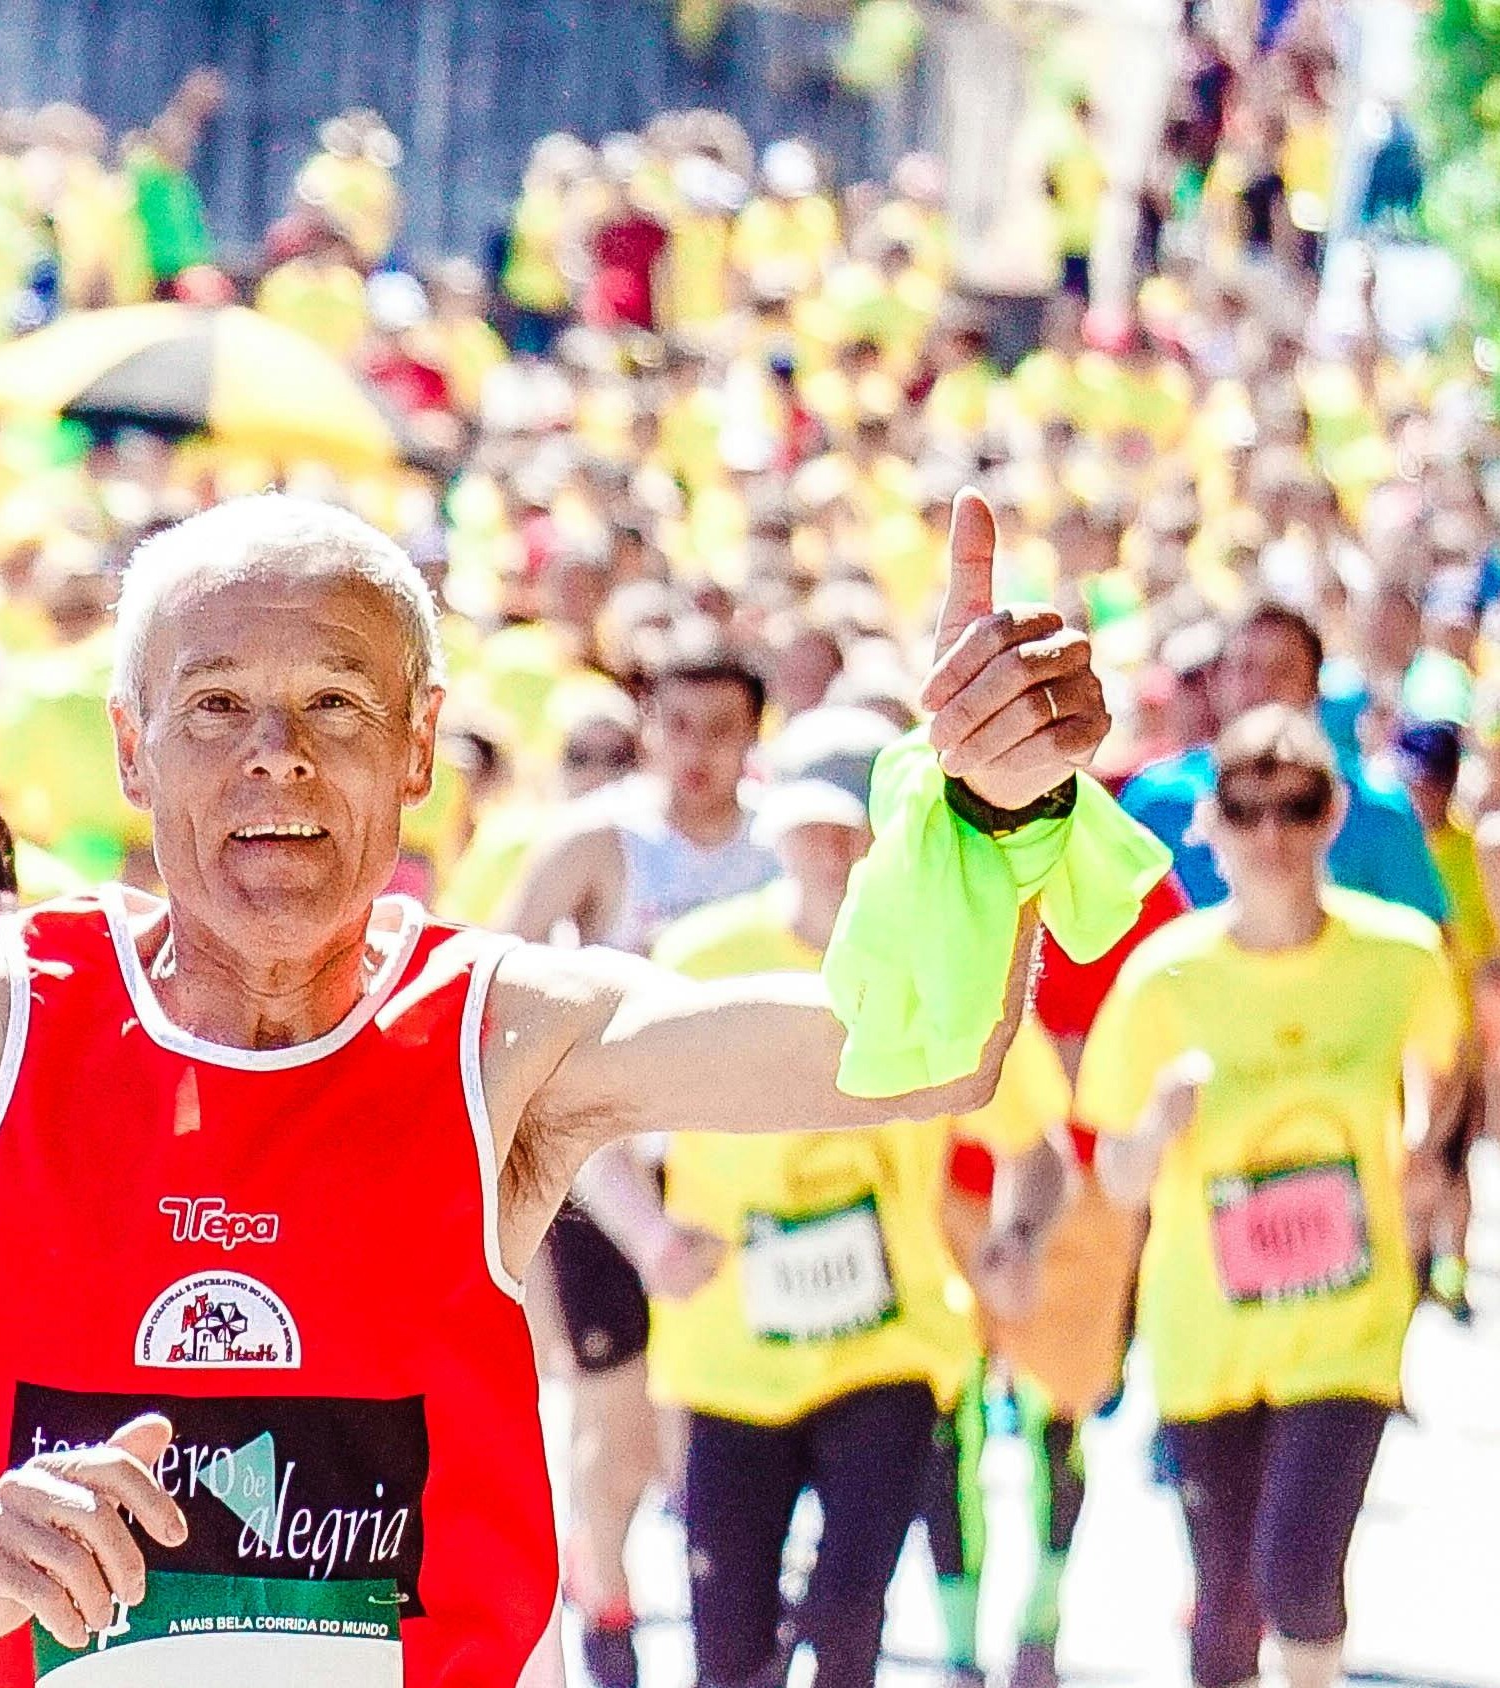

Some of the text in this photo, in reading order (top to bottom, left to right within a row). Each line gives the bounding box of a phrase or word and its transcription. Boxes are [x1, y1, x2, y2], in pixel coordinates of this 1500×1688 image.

[243, 1466, 266, 1497] de
[237, 1461, 409, 1580] alegria
[168, 1616, 389, 1637] A MAIS BELA CORRIDA DO MUNDO
